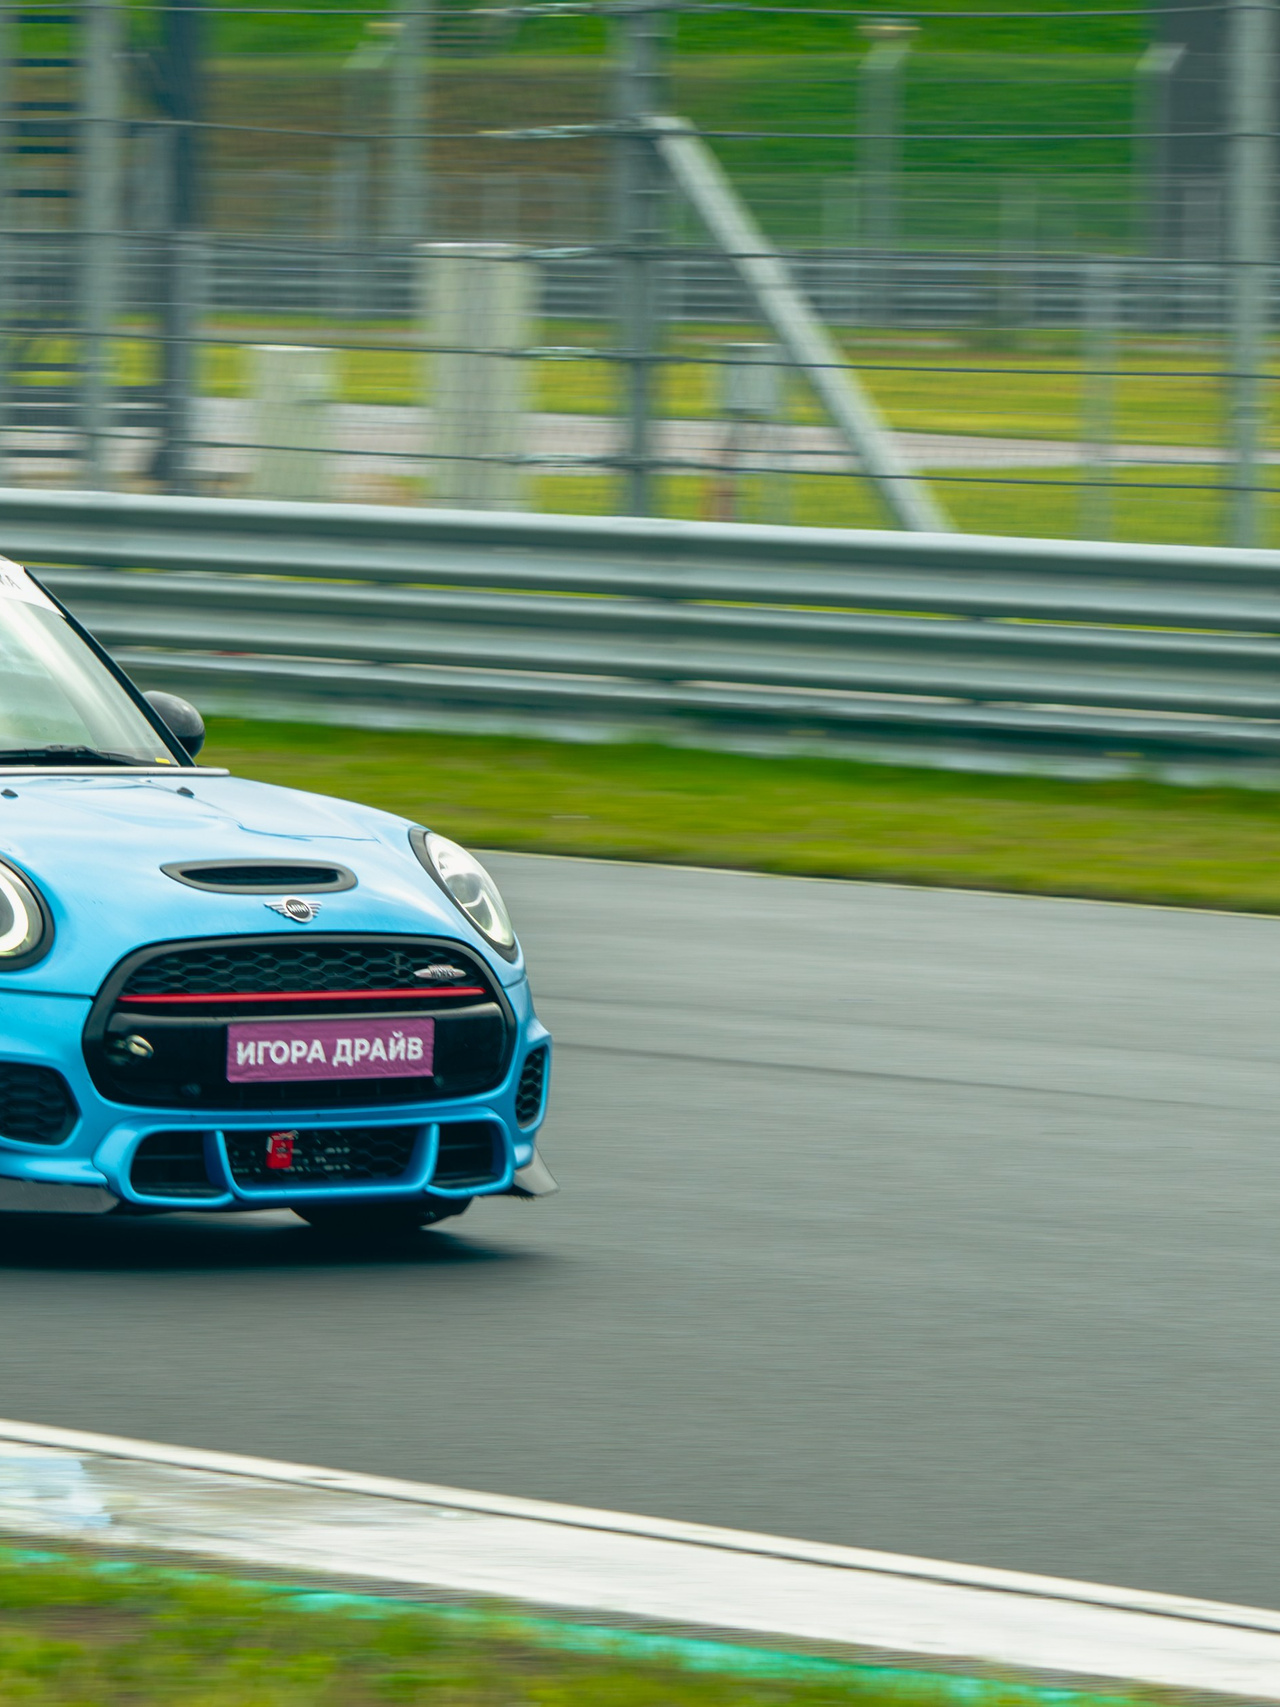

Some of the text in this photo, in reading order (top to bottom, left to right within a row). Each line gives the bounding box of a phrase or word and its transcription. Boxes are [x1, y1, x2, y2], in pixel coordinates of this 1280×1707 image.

[286, 904, 309, 913] MINI
[236, 1030, 424, 1067] ИГОРА ДРАЙВ
